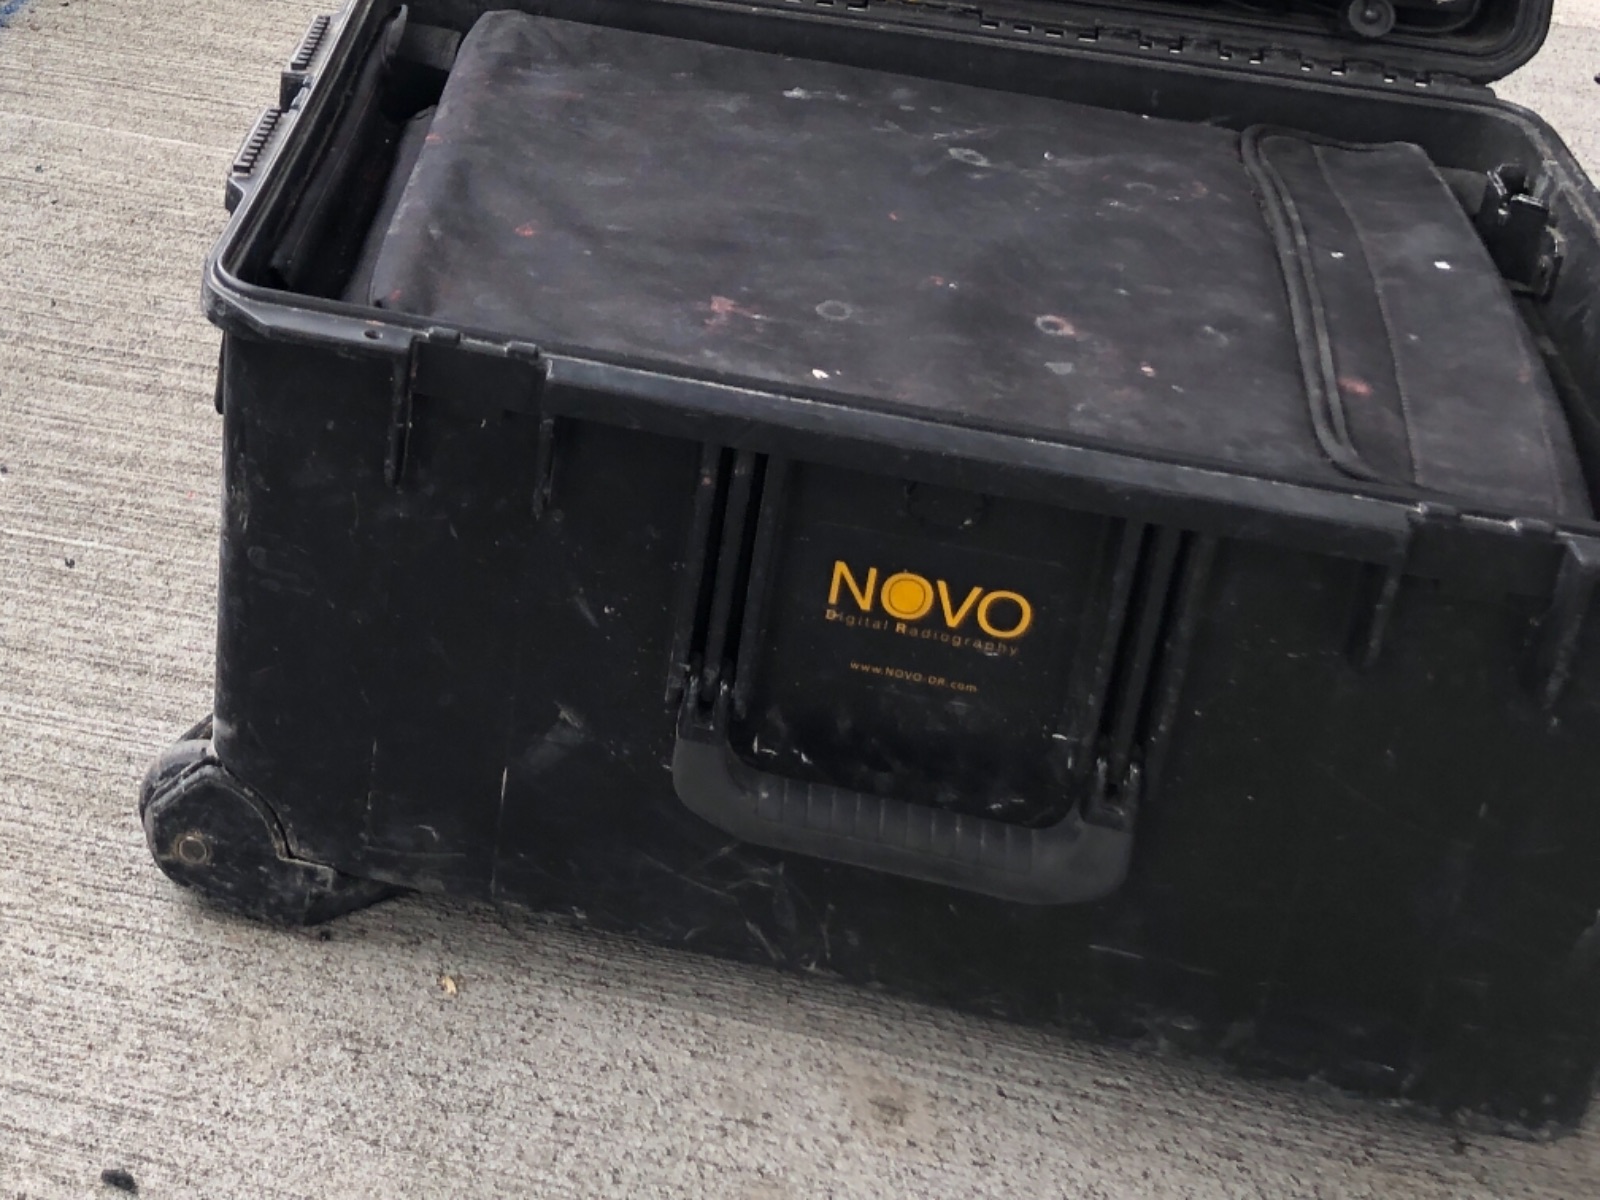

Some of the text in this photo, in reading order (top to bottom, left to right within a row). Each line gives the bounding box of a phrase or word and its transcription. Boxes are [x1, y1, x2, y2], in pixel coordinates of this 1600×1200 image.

[828, 560, 1032, 638] NOVO
[825, 608, 1019, 656] Digital Radiography
[850, 660, 978, 693] www.NOVO-DR.com
